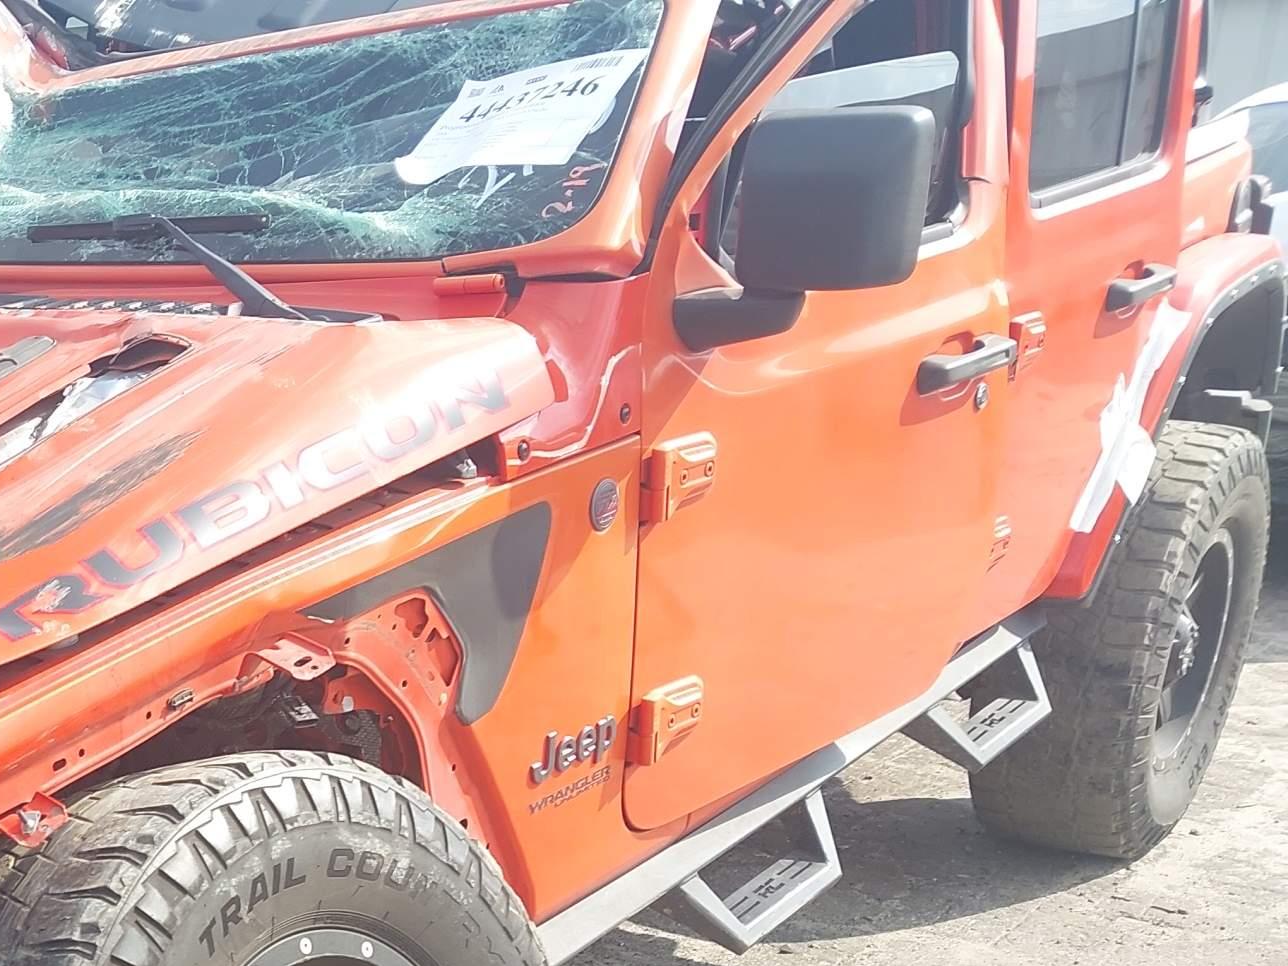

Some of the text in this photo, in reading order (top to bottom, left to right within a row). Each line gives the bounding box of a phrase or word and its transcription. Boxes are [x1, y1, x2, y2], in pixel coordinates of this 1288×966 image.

[529, 715, 617, 785] Jeep
[528, 764, 611, 815] WRANGLER
[199, 857, 307, 959] TRAIL
